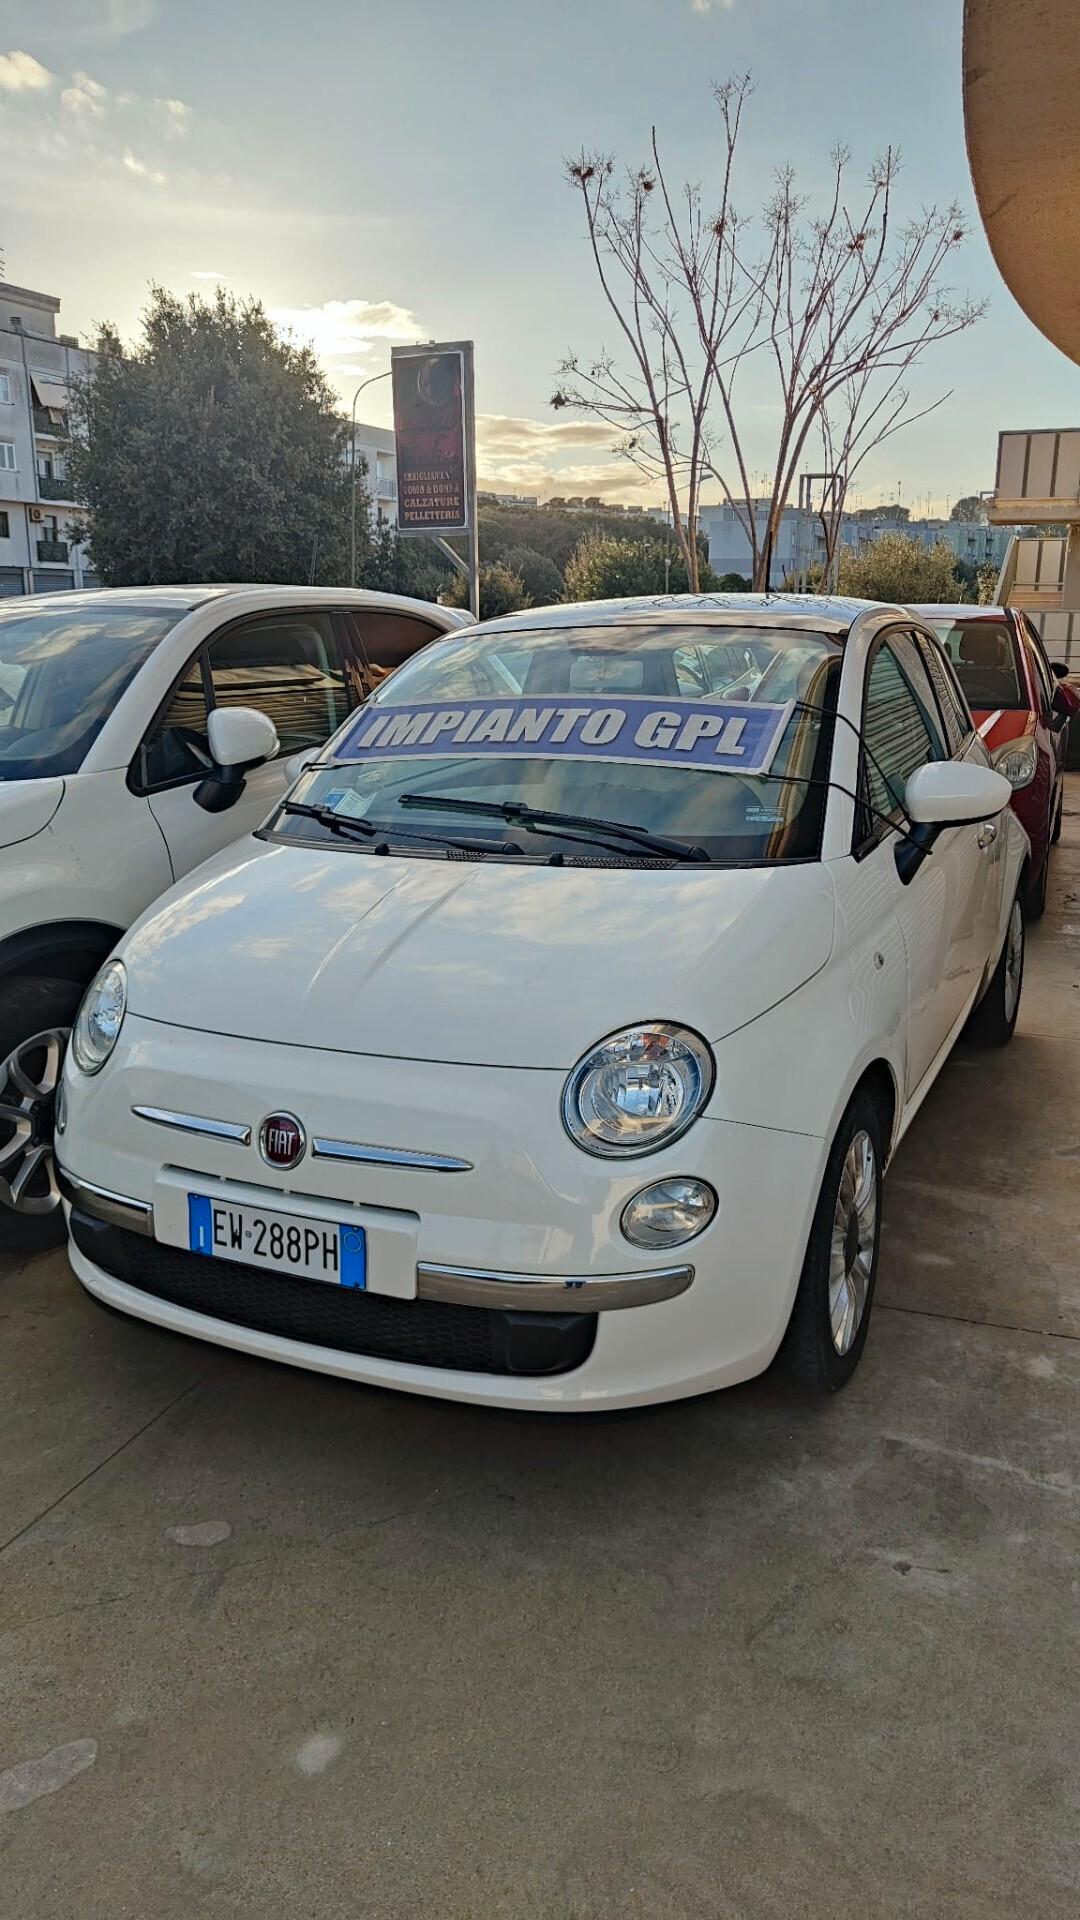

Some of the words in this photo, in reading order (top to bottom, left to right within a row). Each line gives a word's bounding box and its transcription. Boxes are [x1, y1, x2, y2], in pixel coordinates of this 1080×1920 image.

[404, 497, 460, 508] CALZATURE
[404, 510, 460, 521] PELLETTERIA
[358, 708, 627, 748] IMPIANTO
[634, 711, 748, 755] GPL
[268, 1128, 295, 1156] FIAT
